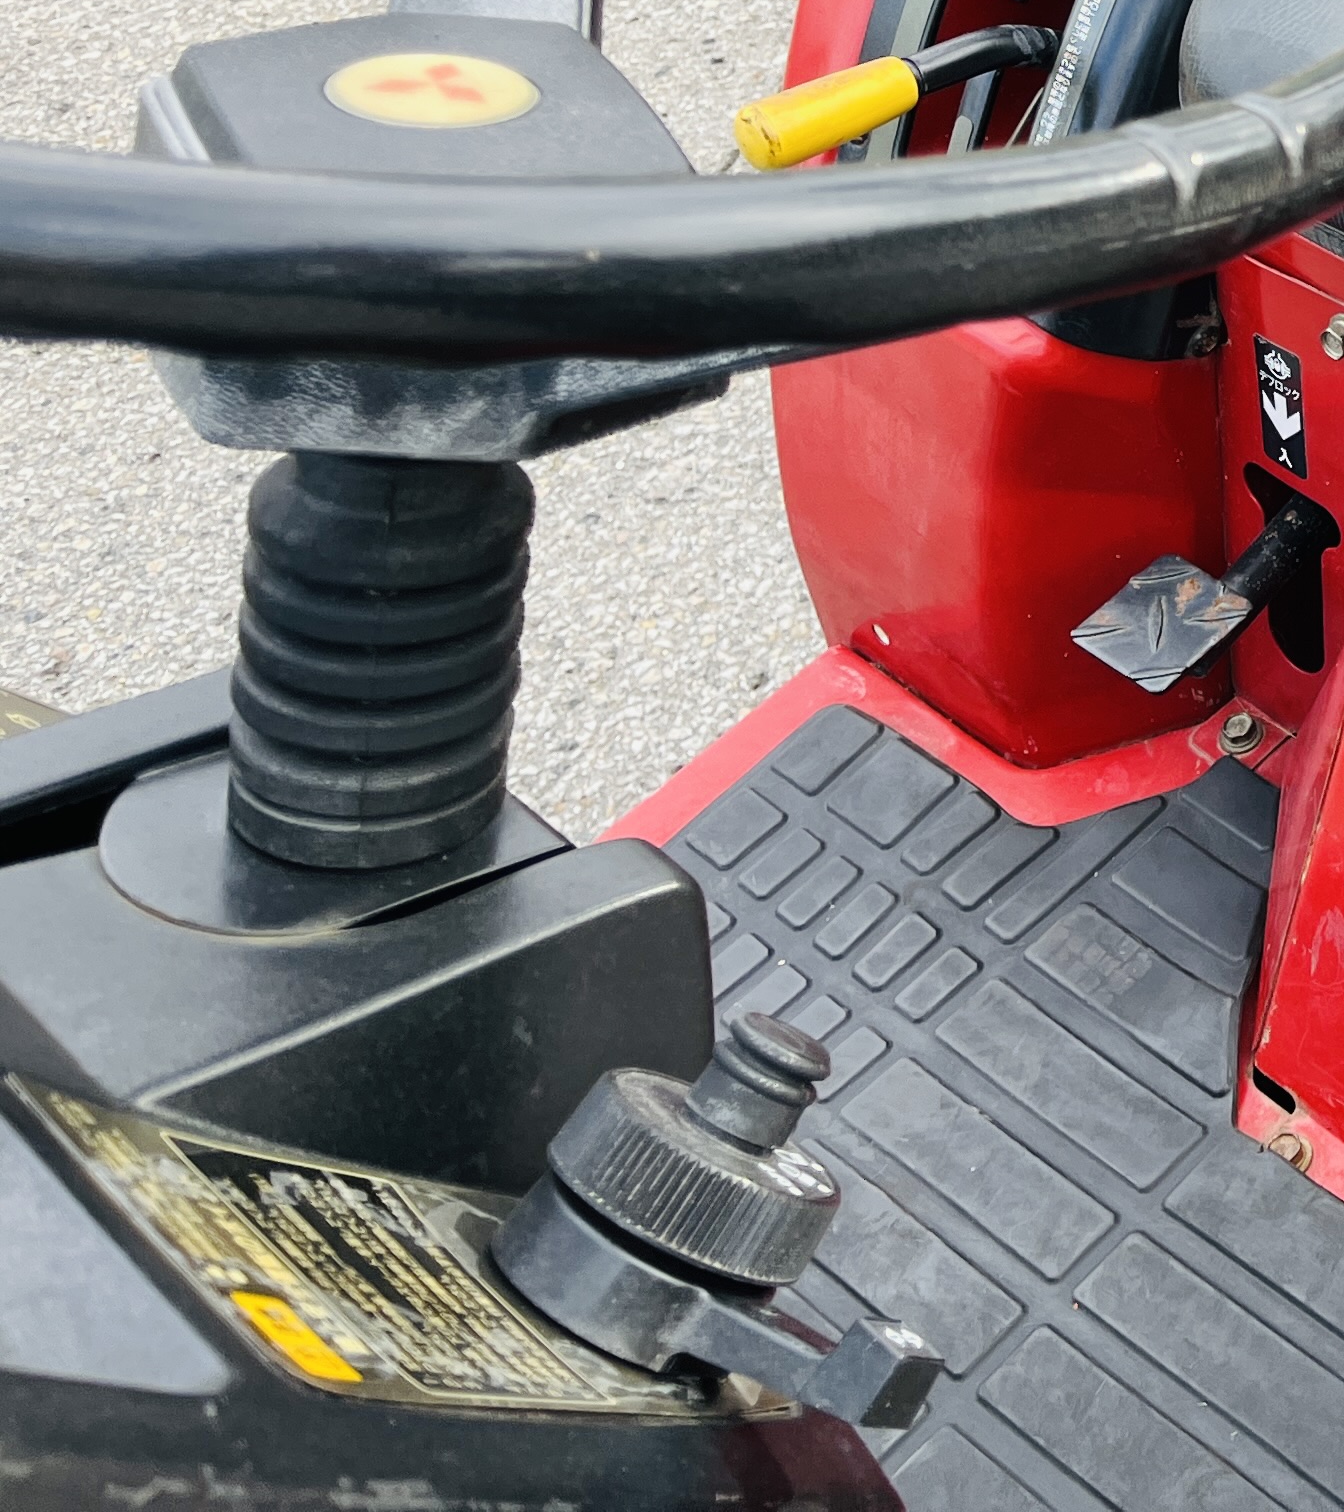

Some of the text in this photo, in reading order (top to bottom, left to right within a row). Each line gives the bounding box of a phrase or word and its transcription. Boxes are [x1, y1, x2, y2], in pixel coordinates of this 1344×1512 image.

[1259, 369, 1301, 401] デフロック
[1279, 447, 1293, 469] 入
